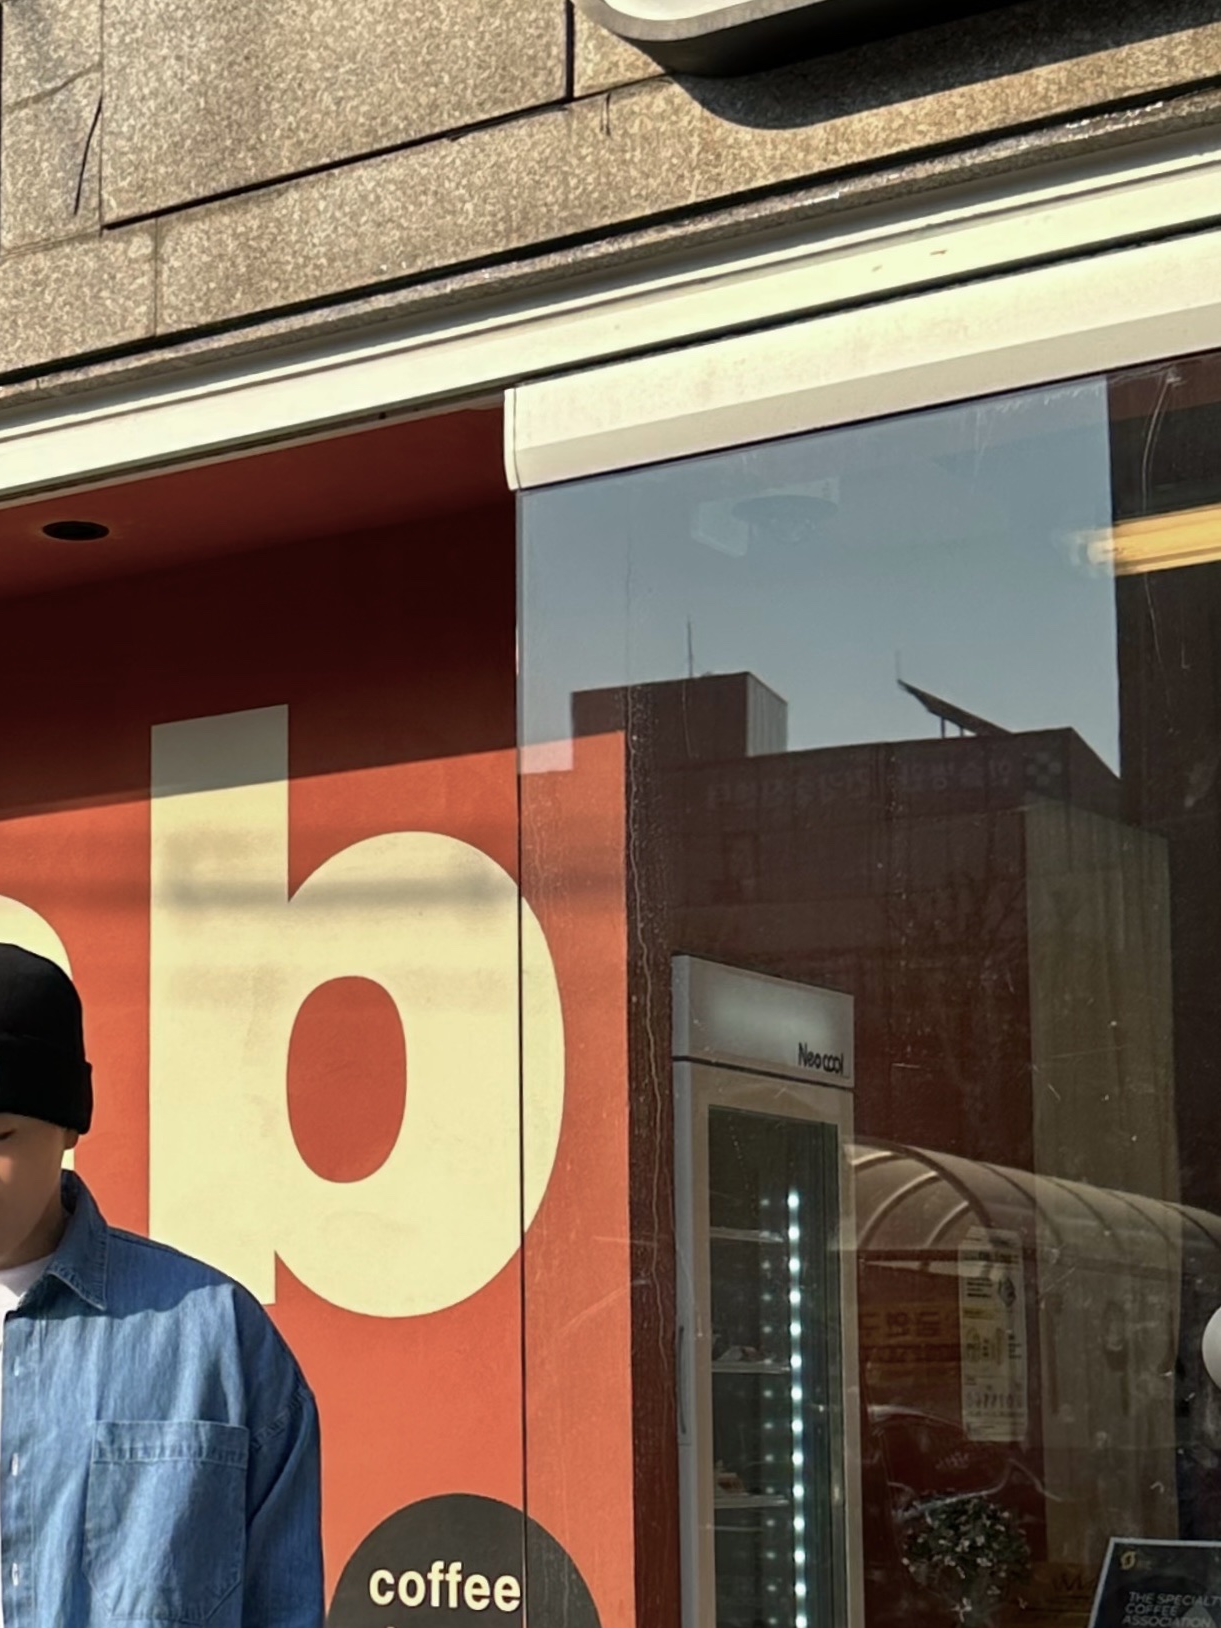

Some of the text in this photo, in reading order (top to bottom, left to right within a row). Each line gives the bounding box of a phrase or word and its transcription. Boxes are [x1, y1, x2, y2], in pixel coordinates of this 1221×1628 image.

[368, 1560, 521, 1612] coffee
[1129, 1591, 1221, 1606] THE SPECIALT
[1125, 1602, 1178, 1617] COFFEE
[1122, 1614, 1212, 1628] ASSOCIATION
